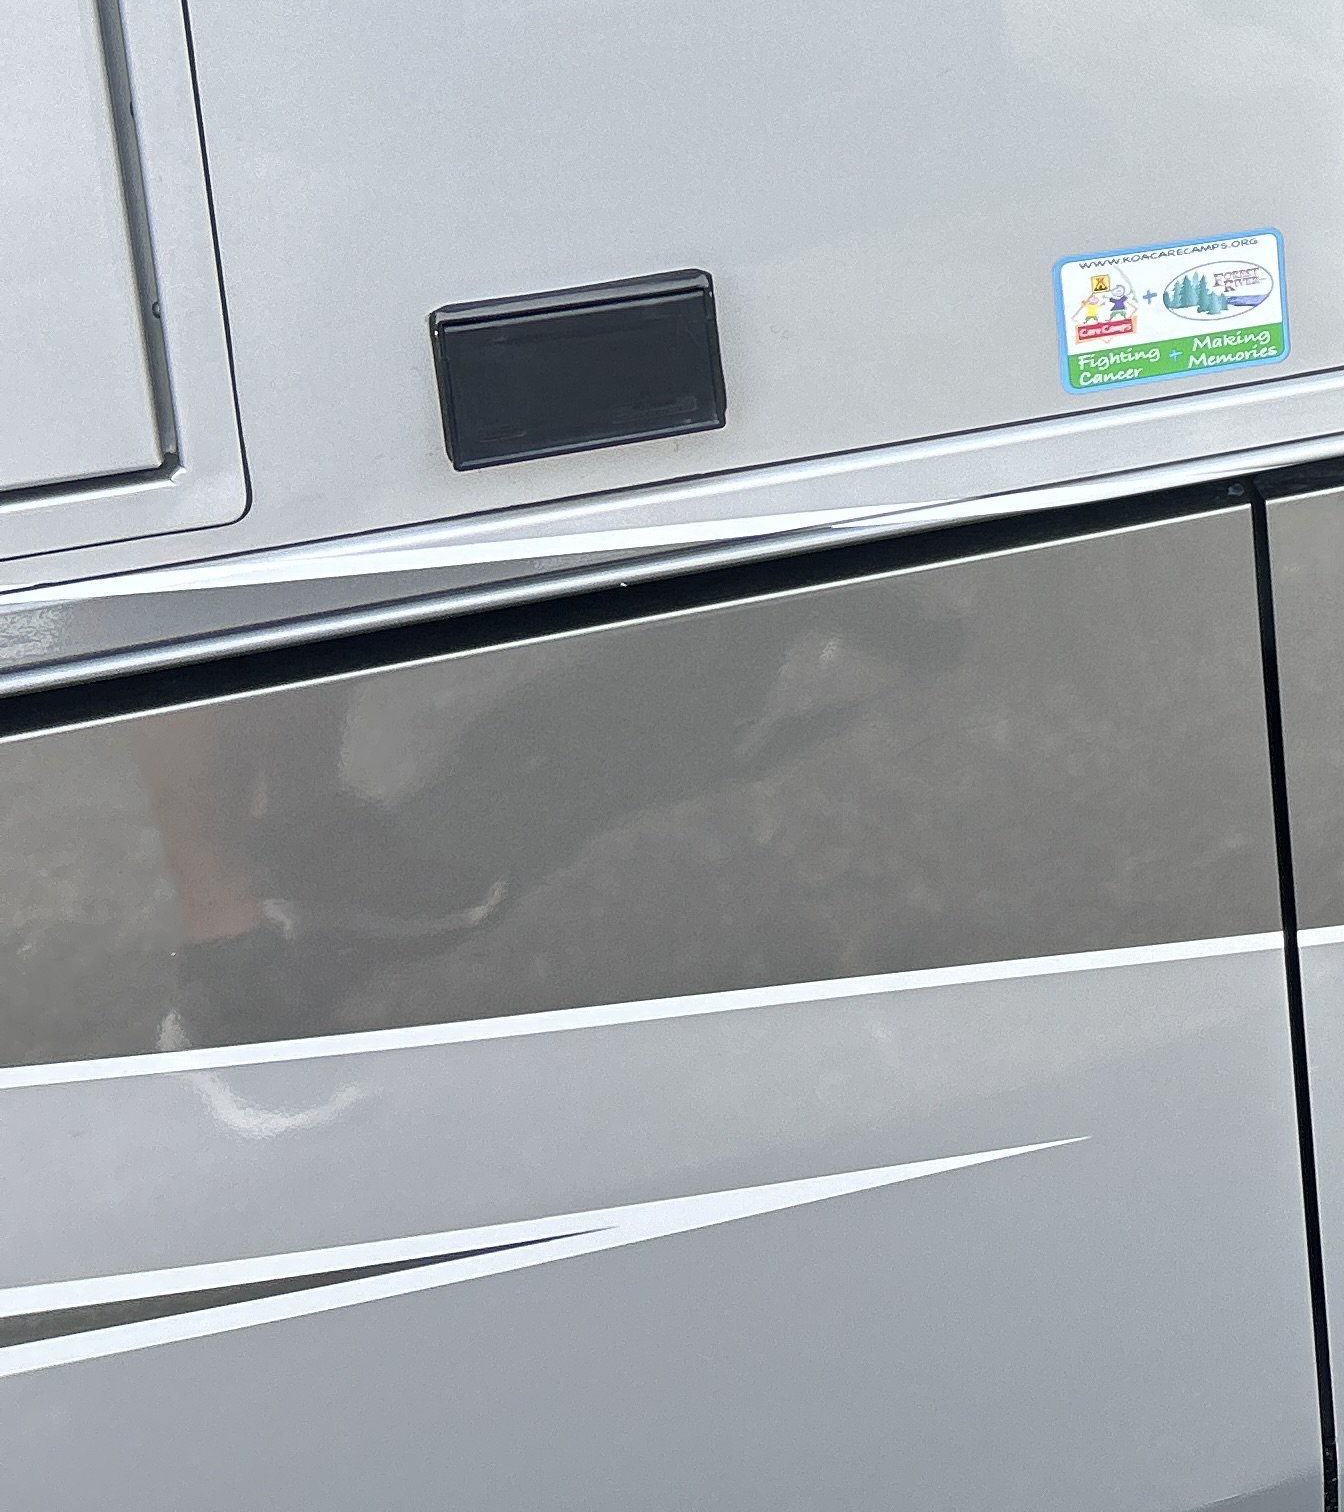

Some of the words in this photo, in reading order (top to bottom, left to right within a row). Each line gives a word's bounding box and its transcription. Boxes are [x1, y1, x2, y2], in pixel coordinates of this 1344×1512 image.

[1078, 237, 1259, 270] WWW.KOACARECAMPS.ORG
[1077, 346, 1162, 371] Fighting
[1191, 329, 1271, 352] Making
[1079, 365, 1143, 386] Cancer
[1187, 344, 1278, 369] Memories
